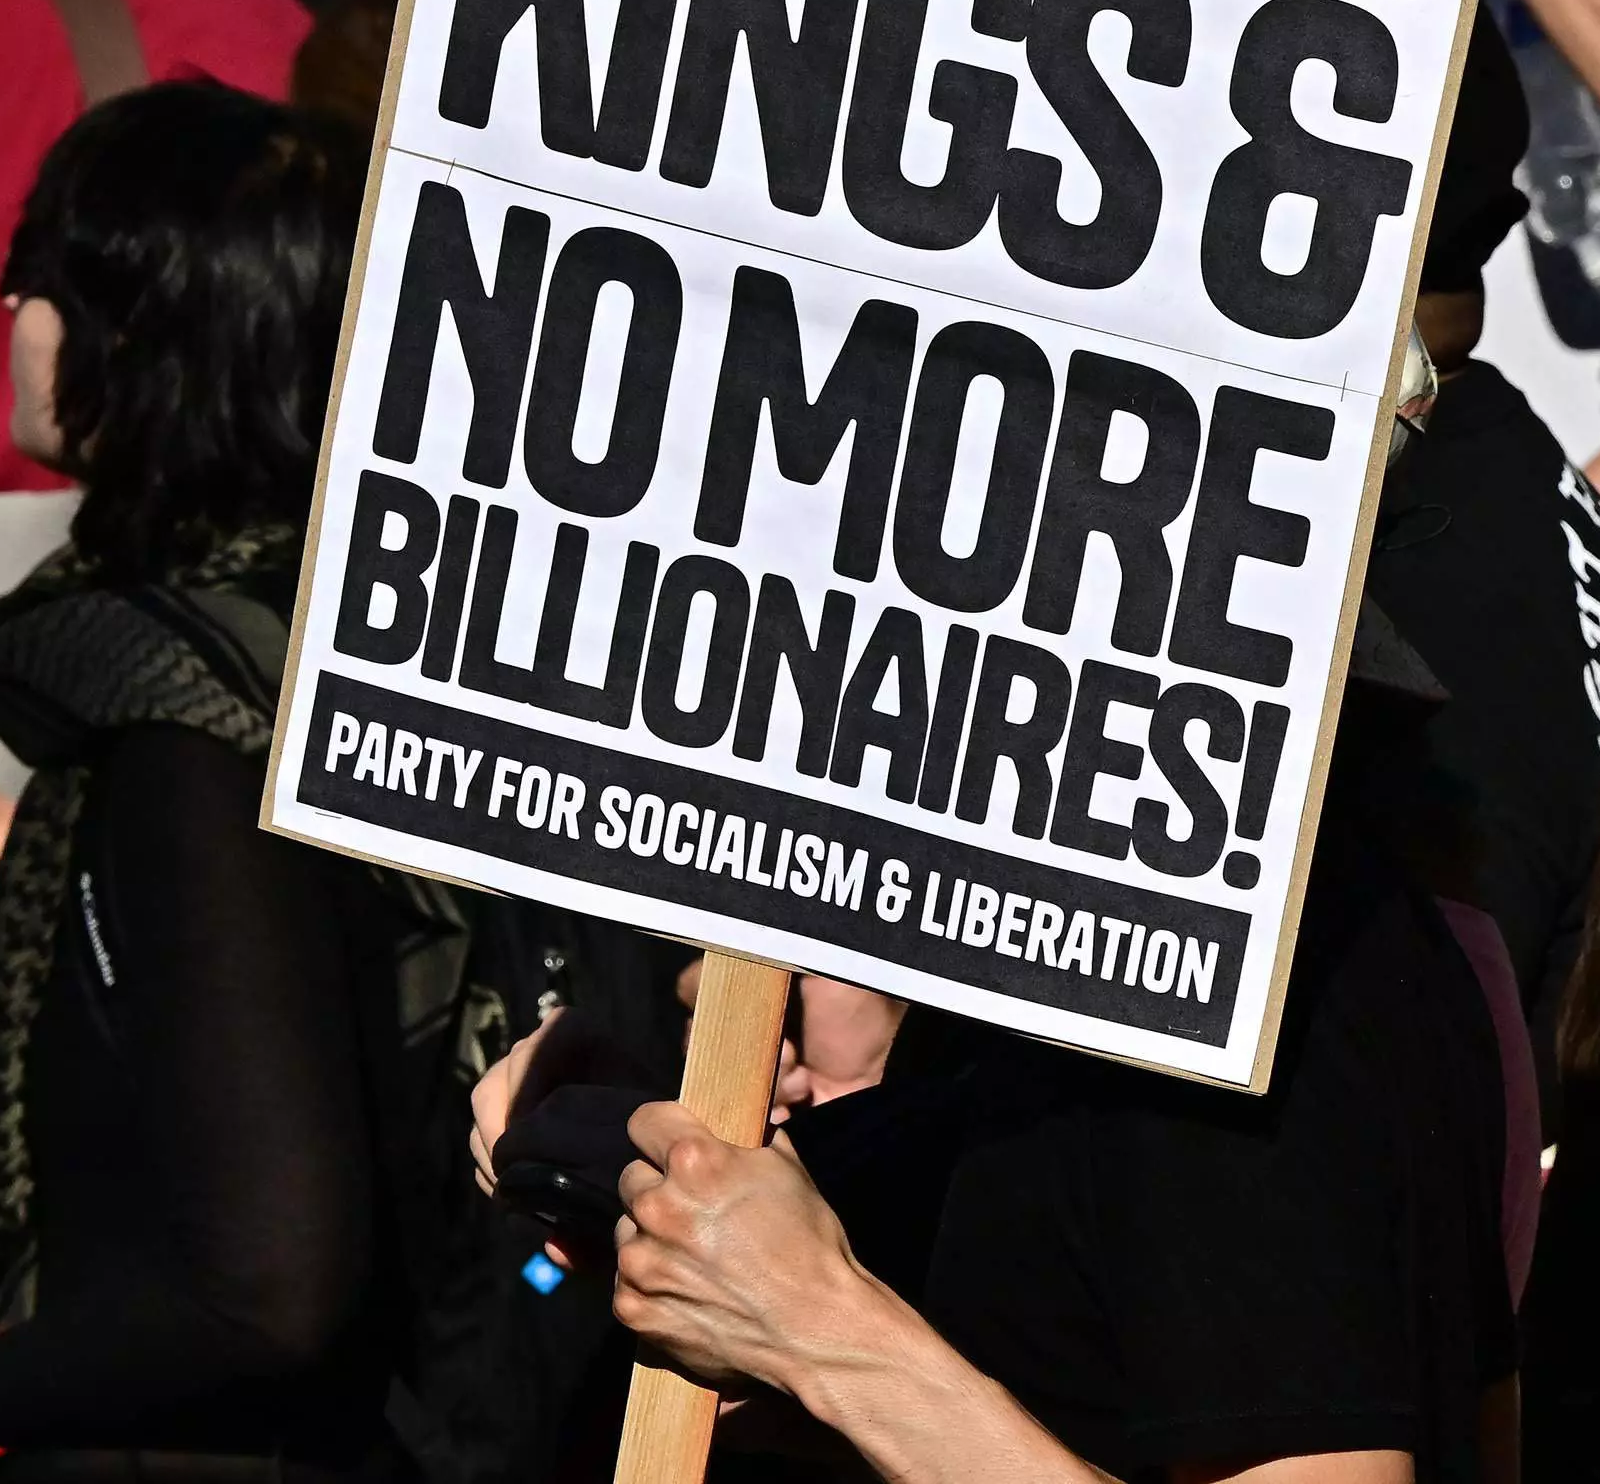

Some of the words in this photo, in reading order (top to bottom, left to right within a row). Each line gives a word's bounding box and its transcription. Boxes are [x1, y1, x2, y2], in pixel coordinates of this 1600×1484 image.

[373, 181, 682, 517] NO
[694, 266, 1335, 687] MORE
[325, 711, 483, 808] PARTY
[488, 757, 586, 839] FOR
[595, 786, 868, 911] SOCIALISM
[876, 859, 912, 922] &
[920, 871, 1219, 1003] LIBERATION
[334, 470, 1290, 890] BILLIONAIRES!
